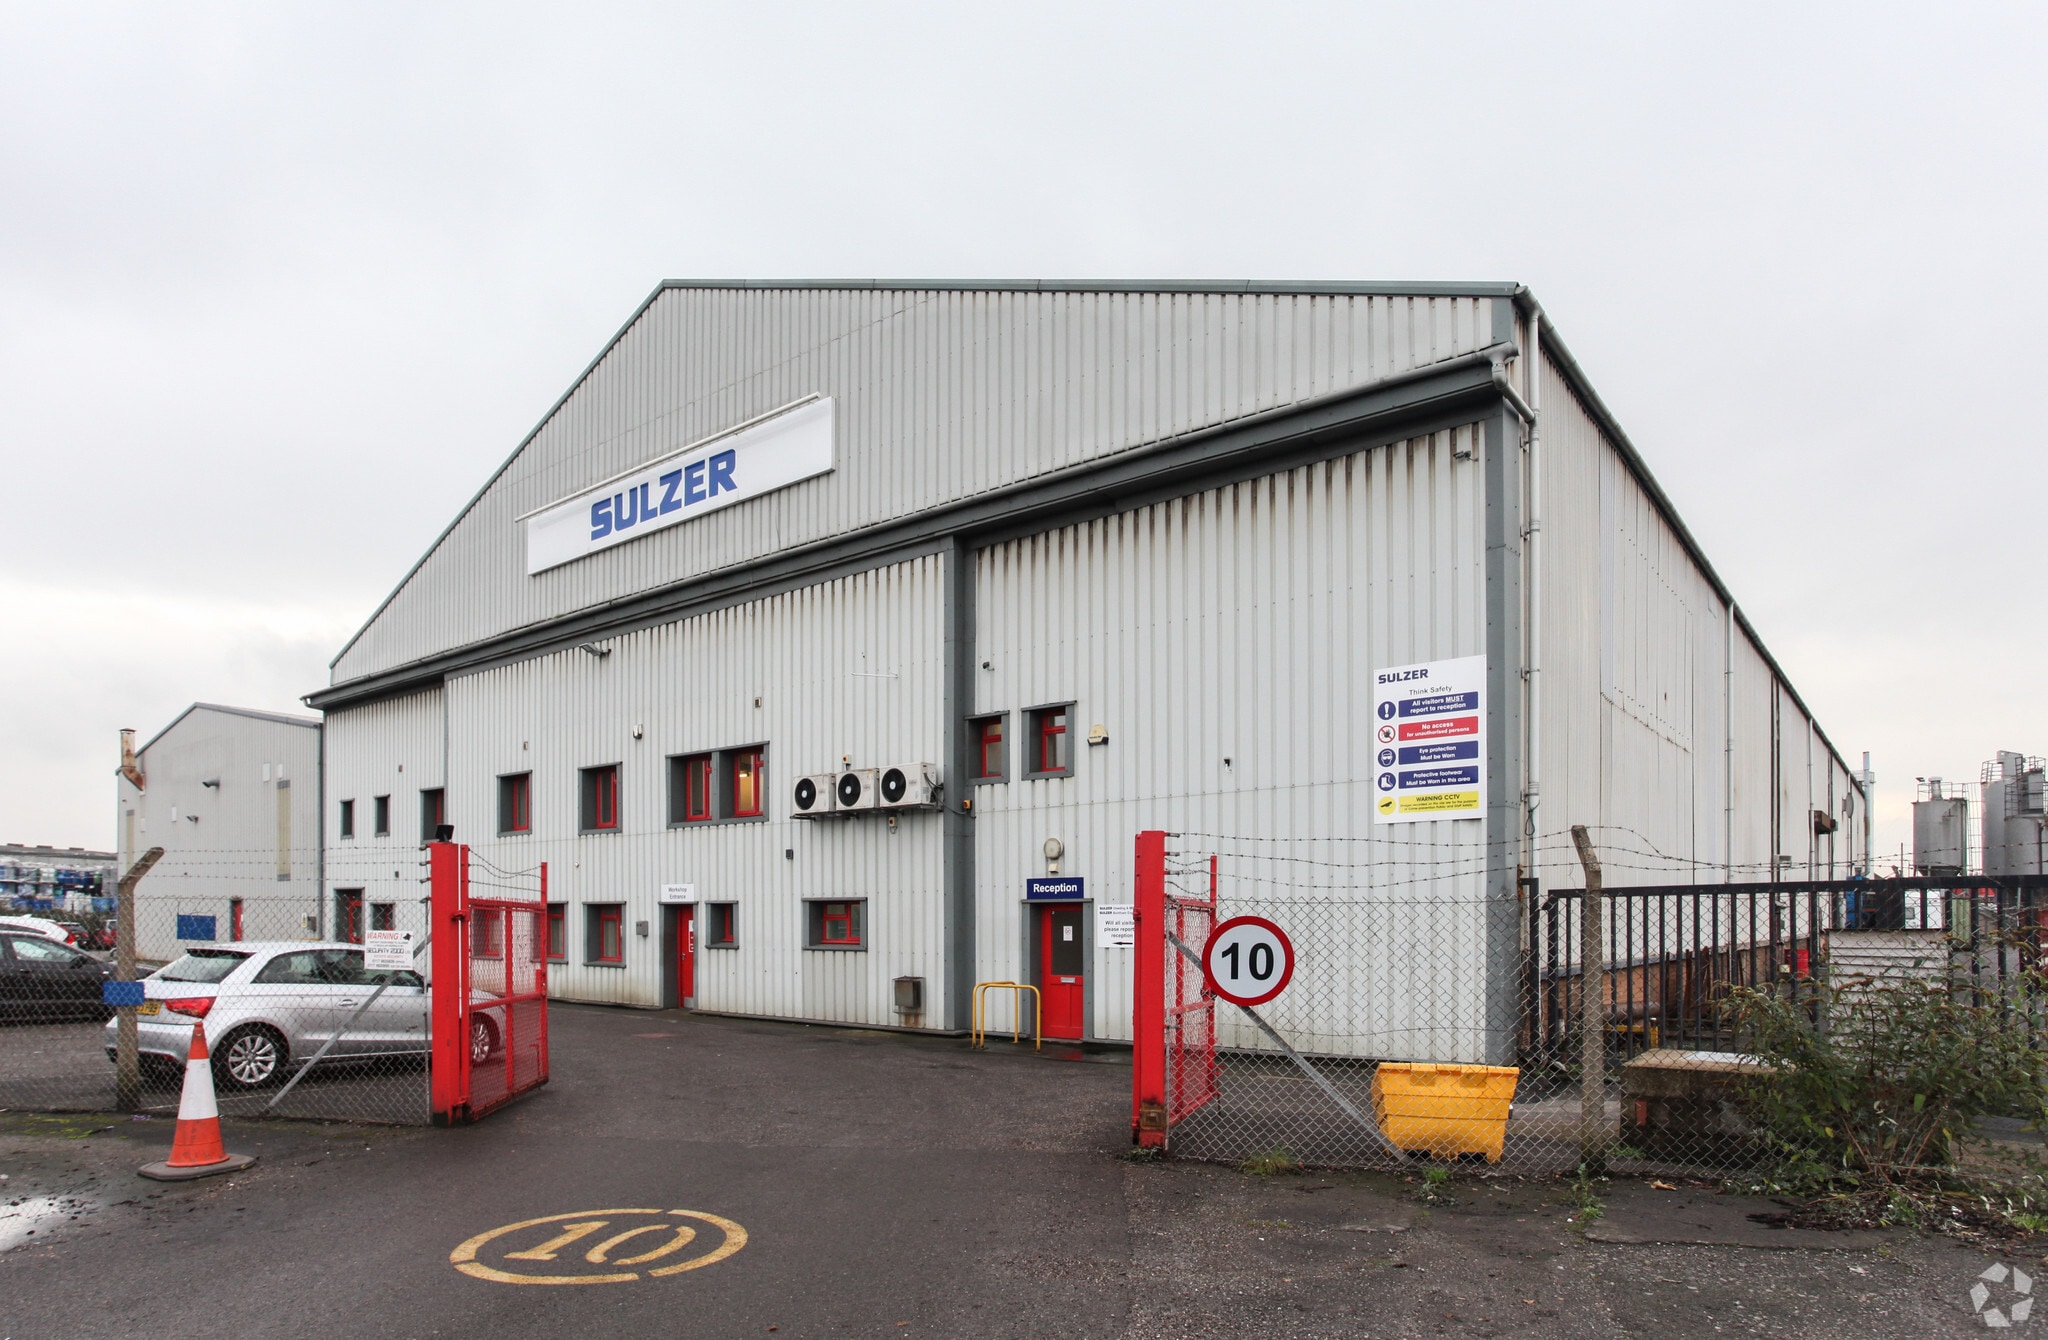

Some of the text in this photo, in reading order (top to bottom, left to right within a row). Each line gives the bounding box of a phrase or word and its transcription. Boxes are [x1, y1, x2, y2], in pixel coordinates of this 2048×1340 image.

[591, 448, 738, 541] SULZER
[1378, 668, 1428, 684] SULZER
[1034, 883, 1077, 894] Reception
[1222, 942, 1274, 980] 10
[503, 1220, 696, 1265] 10
